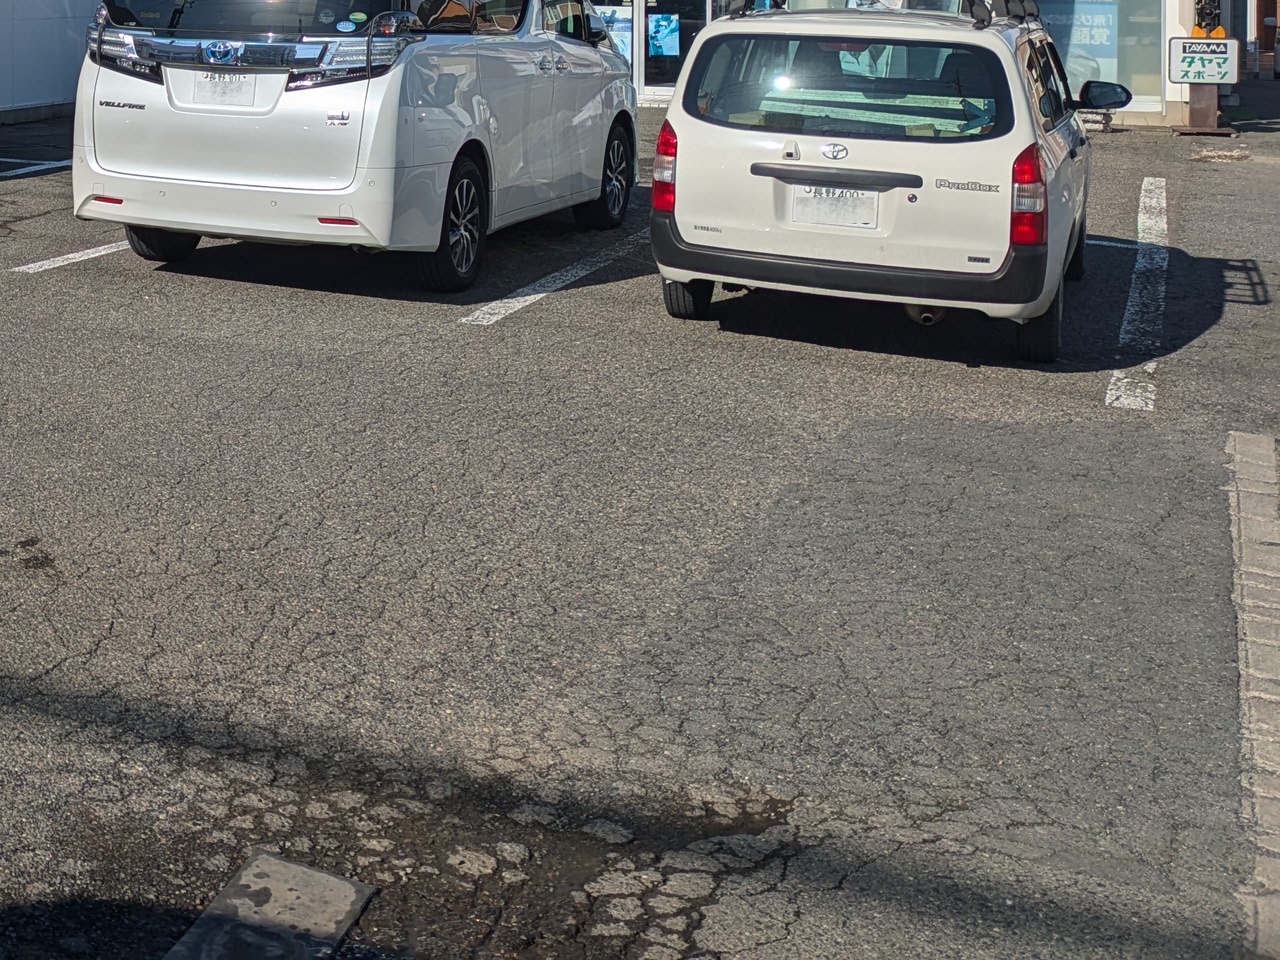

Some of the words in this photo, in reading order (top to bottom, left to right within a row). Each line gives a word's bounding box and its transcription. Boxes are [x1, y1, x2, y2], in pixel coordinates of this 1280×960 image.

[1184, 43, 1226, 53] TAYAMA
[1180, 55, 1229, 69] タヤマ
[1180, 70, 1229, 80] スポーツ
[98, 100, 146, 111] VELLFIRE
